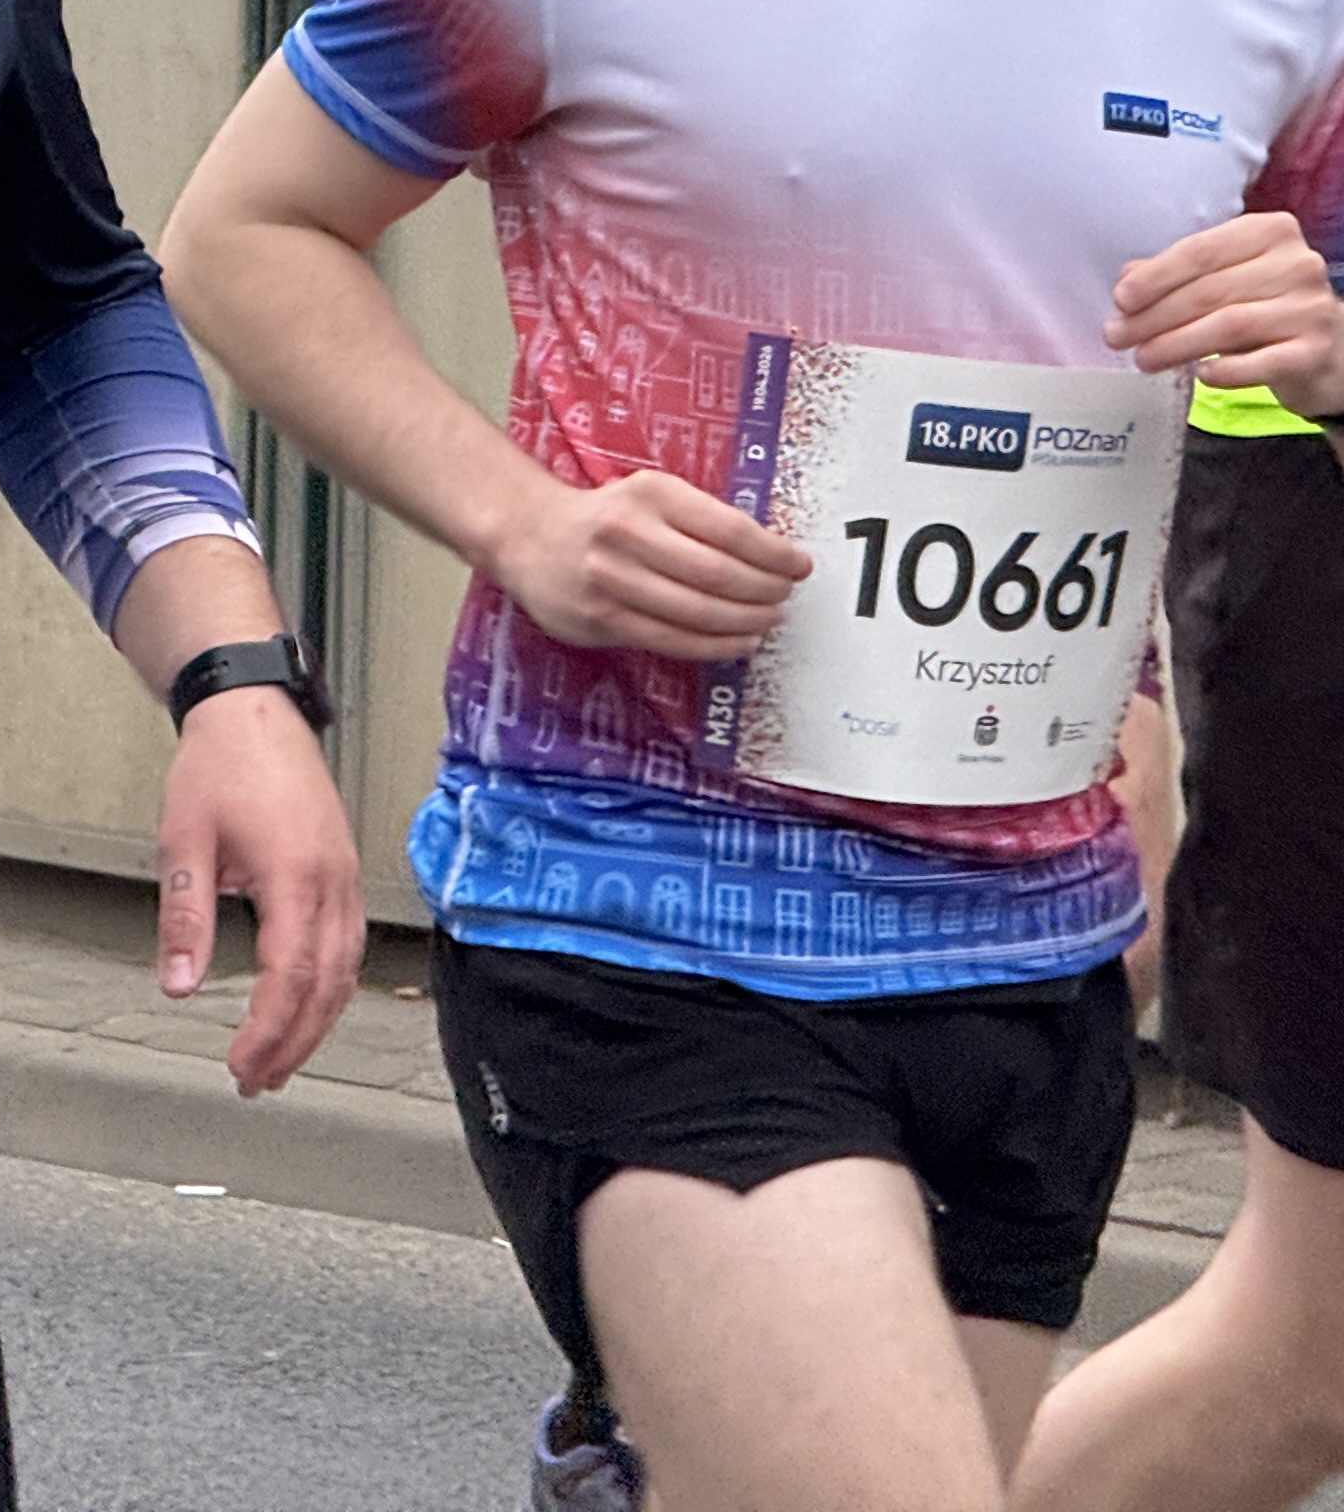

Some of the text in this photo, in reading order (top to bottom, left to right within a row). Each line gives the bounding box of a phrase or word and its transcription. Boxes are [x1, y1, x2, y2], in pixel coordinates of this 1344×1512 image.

[747, 444, 766, 461] D
[919, 420, 1019, 454] 18.PKO
[844, 517, 1130, 633] 10661
[914, 650, 1057, 692] Krzysztof
[703, 685, 735, 748] M30
